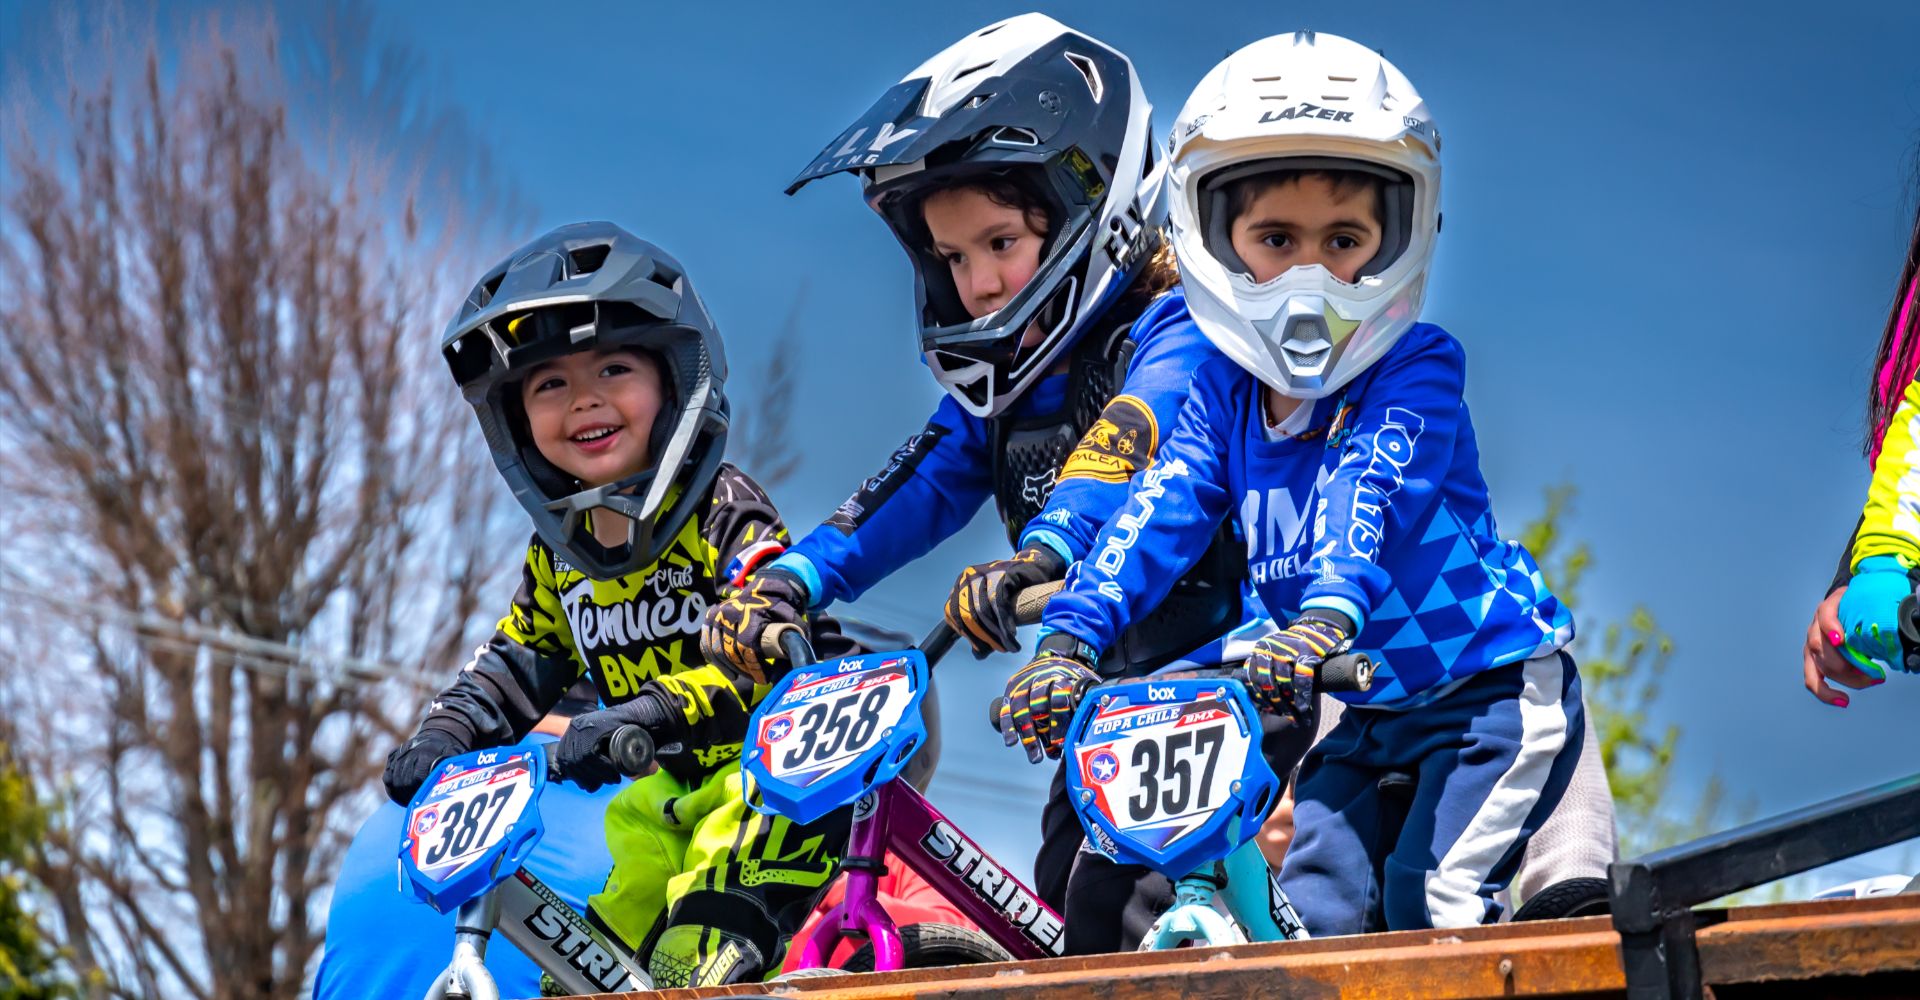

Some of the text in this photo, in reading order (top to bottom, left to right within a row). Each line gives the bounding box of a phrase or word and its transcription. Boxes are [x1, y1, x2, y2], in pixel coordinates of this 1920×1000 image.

[1258, 102, 1354, 124] LAZER
[1240, 464, 1330, 560] BM
[645, 565, 693, 598] Club
[559, 579, 714, 669] Temuco
[598, 639, 696, 698] BMX
[838, 658, 864, 673] box
[781, 674, 893, 706] COPA CHILE BMX
[1147, 685, 1176, 701] box
[783, 684, 891, 770] 358
[1093, 707, 1216, 735] COPA CHILE BMX
[477, 751, 498, 765] box
[1128, 723, 1226, 823] 357
[425, 782, 518, 865] 387
